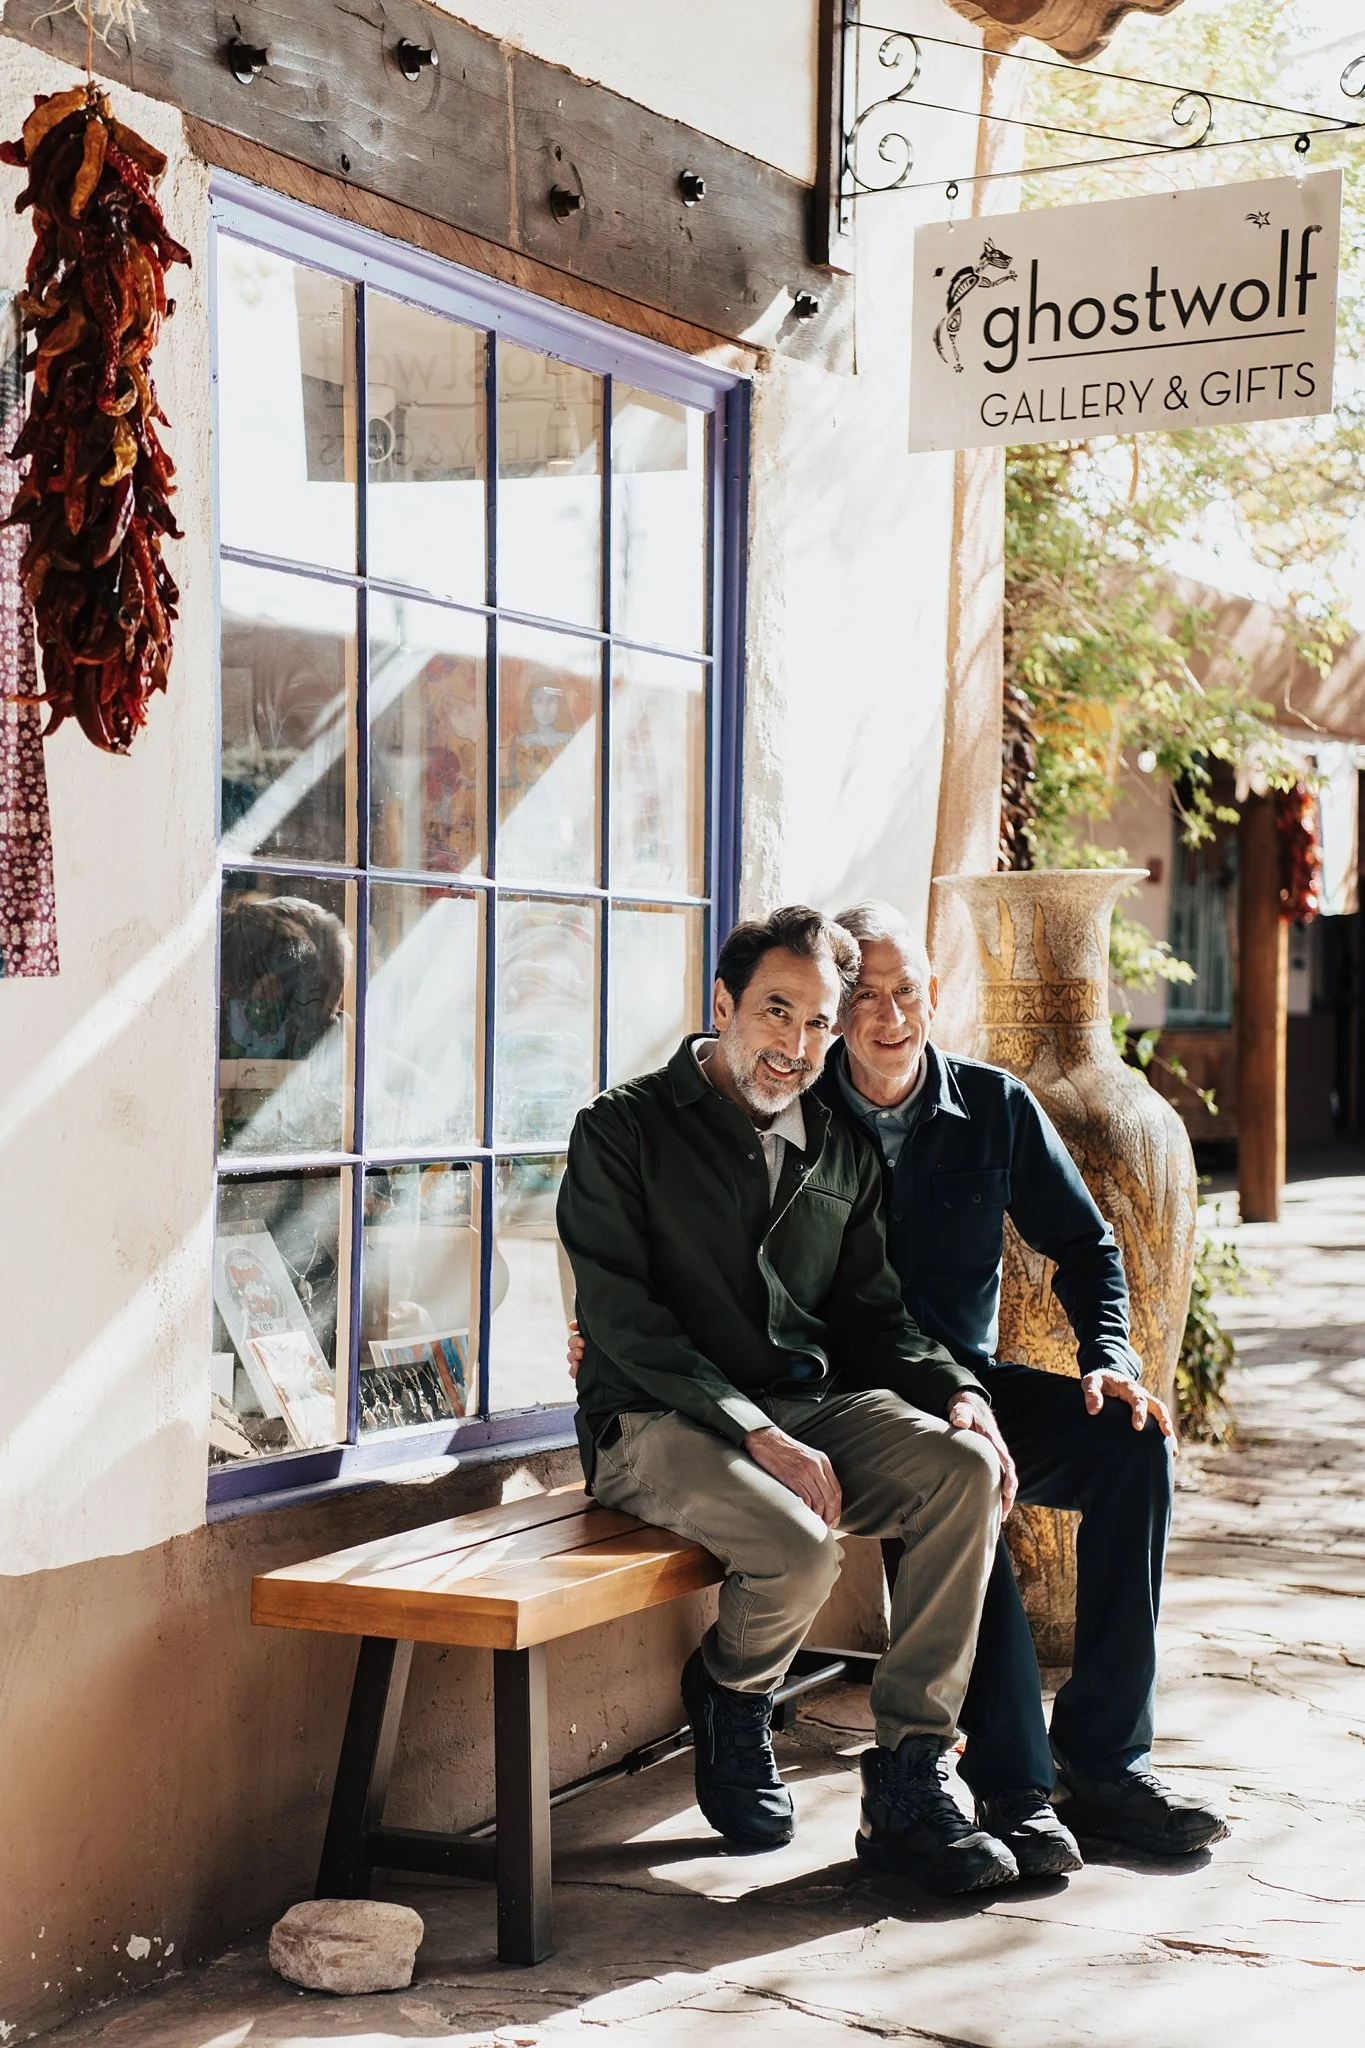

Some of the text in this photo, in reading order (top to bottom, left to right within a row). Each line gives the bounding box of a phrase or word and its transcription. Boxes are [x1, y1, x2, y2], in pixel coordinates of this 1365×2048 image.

[983, 224, 1322, 373] ghostwolf
[981, 361, 1316, 427] GALLERY & GIFTS
